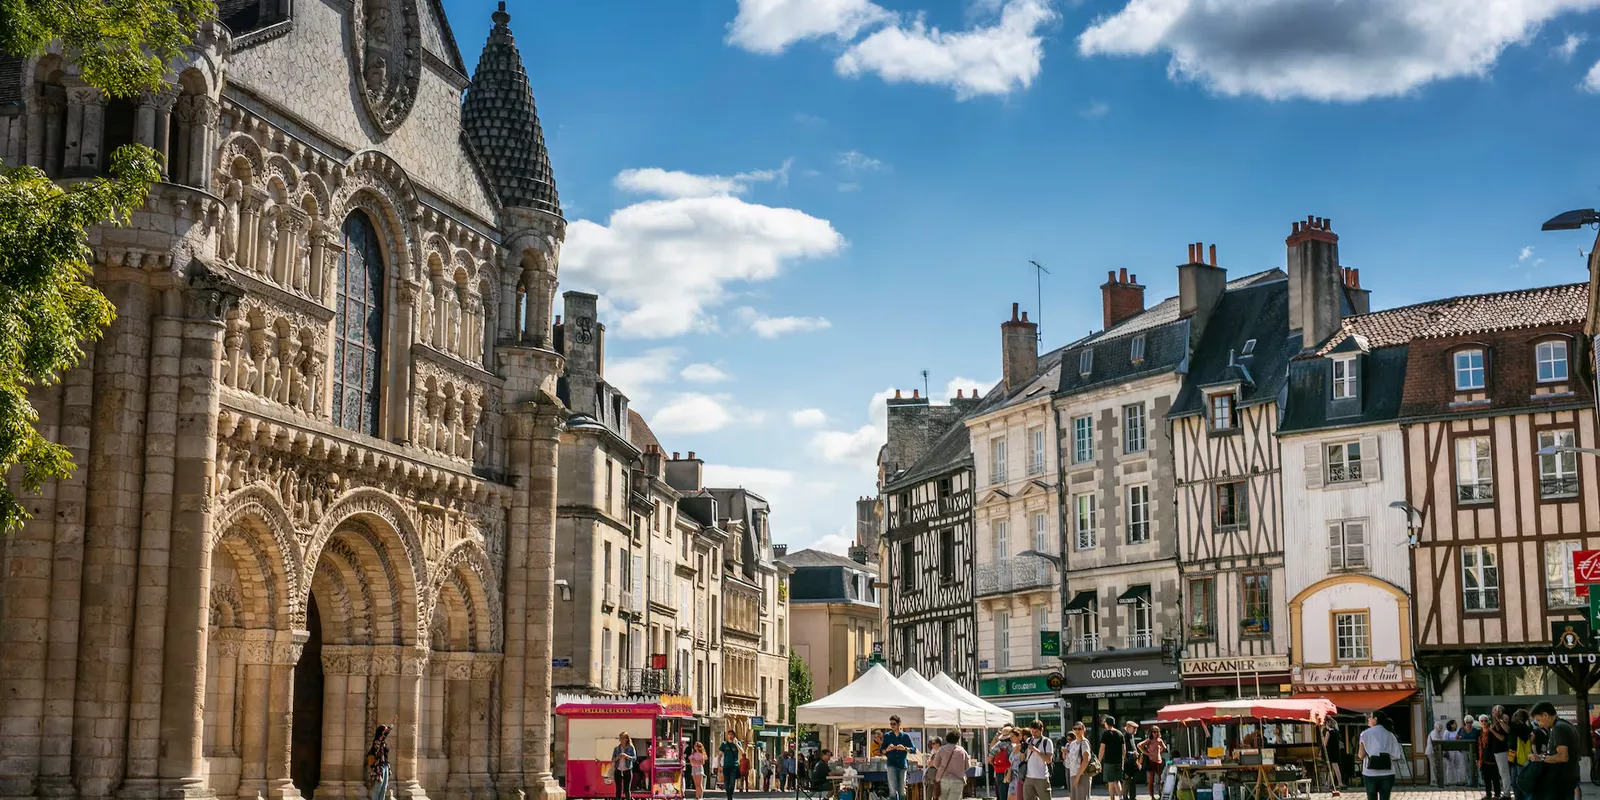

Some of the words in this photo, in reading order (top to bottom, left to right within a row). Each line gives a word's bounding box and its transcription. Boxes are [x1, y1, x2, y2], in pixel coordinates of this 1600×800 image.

[1471, 653, 1538, 666] Maison
[1547, 652, 1569, 664] du
[1183, 660, 1255, 673] L'ARGANIER
[1091, 668, 1131, 679] COLUMBUS
[1307, 670, 1319, 682] Le
[1324, 669, 1360, 682] Fournil
[1362, 667, 1398, 681] d'Elina
[1011, 681, 1037, 691] Groupama
